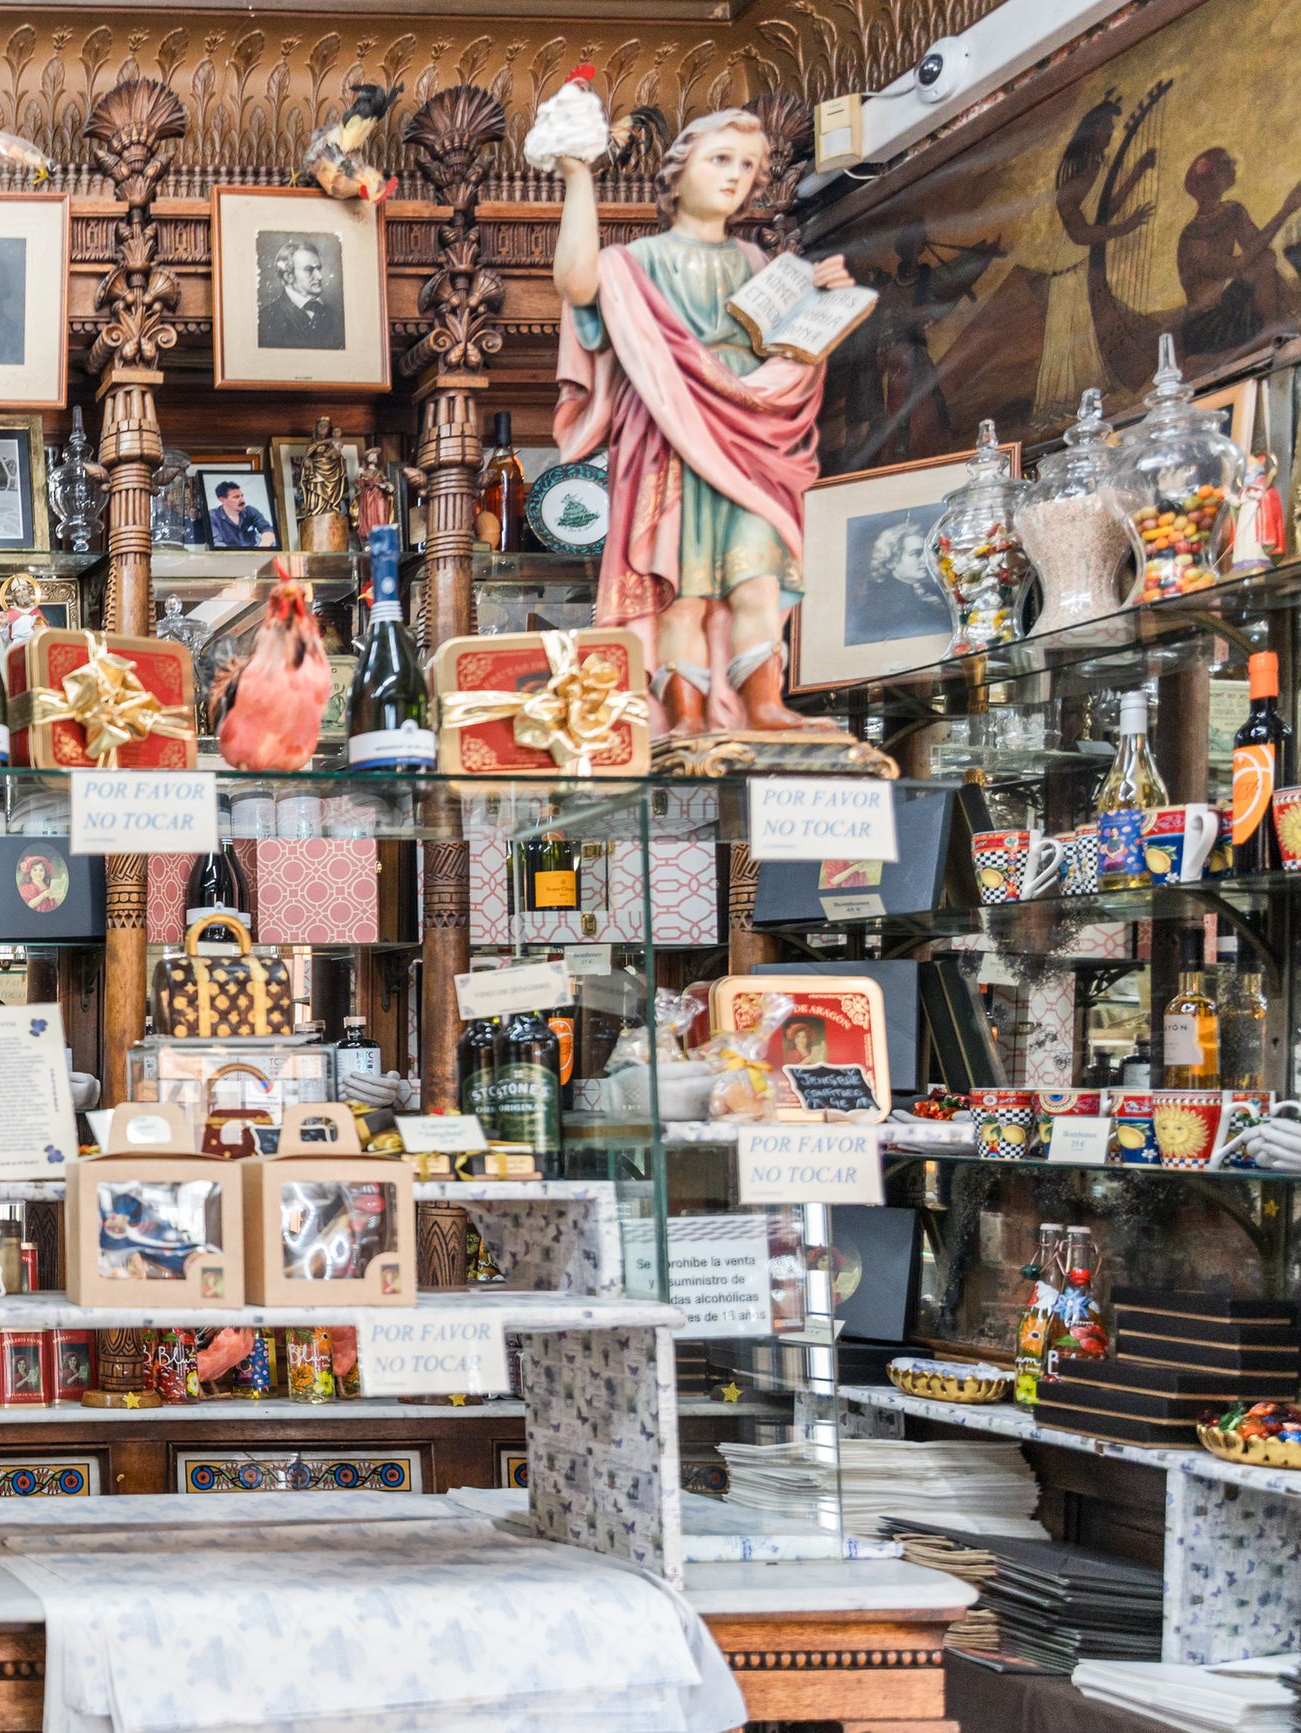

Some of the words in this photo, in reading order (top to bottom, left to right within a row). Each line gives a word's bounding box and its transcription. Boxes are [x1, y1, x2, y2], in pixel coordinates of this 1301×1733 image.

[84, 782, 127, 799] POR
[134, 782, 205, 800] FAVOR
[762, 789, 805, 806] POR
[812, 790, 881, 808] FAVOR
[84, 812, 117, 830] NO
[123, 812, 194, 830] TOCAR
[762, 819, 796, 836] NO
[801, 819, 871, 838] TOCAR
[794, 1004, 808, 1014] DE
[750, 1135, 791, 1153] POR
[797, 1136, 867, 1153] FAVOR
[750, 1166, 782, 1183] NO
[787, 1166, 857, 1184] TOCAR
[636, 1258, 651, 1270] Se
[711, 1256, 721, 1267] la
[724, 1256, 756, 1266] venta
[669, 1276, 728, 1287] suministro
[731, 1274, 745, 1284] de
[695, 1292, 759, 1304] alcohólicas
[704, 1312, 718, 1322] de
[371, 1324, 414, 1342] POR
[420, 1323, 491, 1341] FAVOR
[288, 1343, 331, 1364] Blum
[373, 1356, 405, 1374] NO
